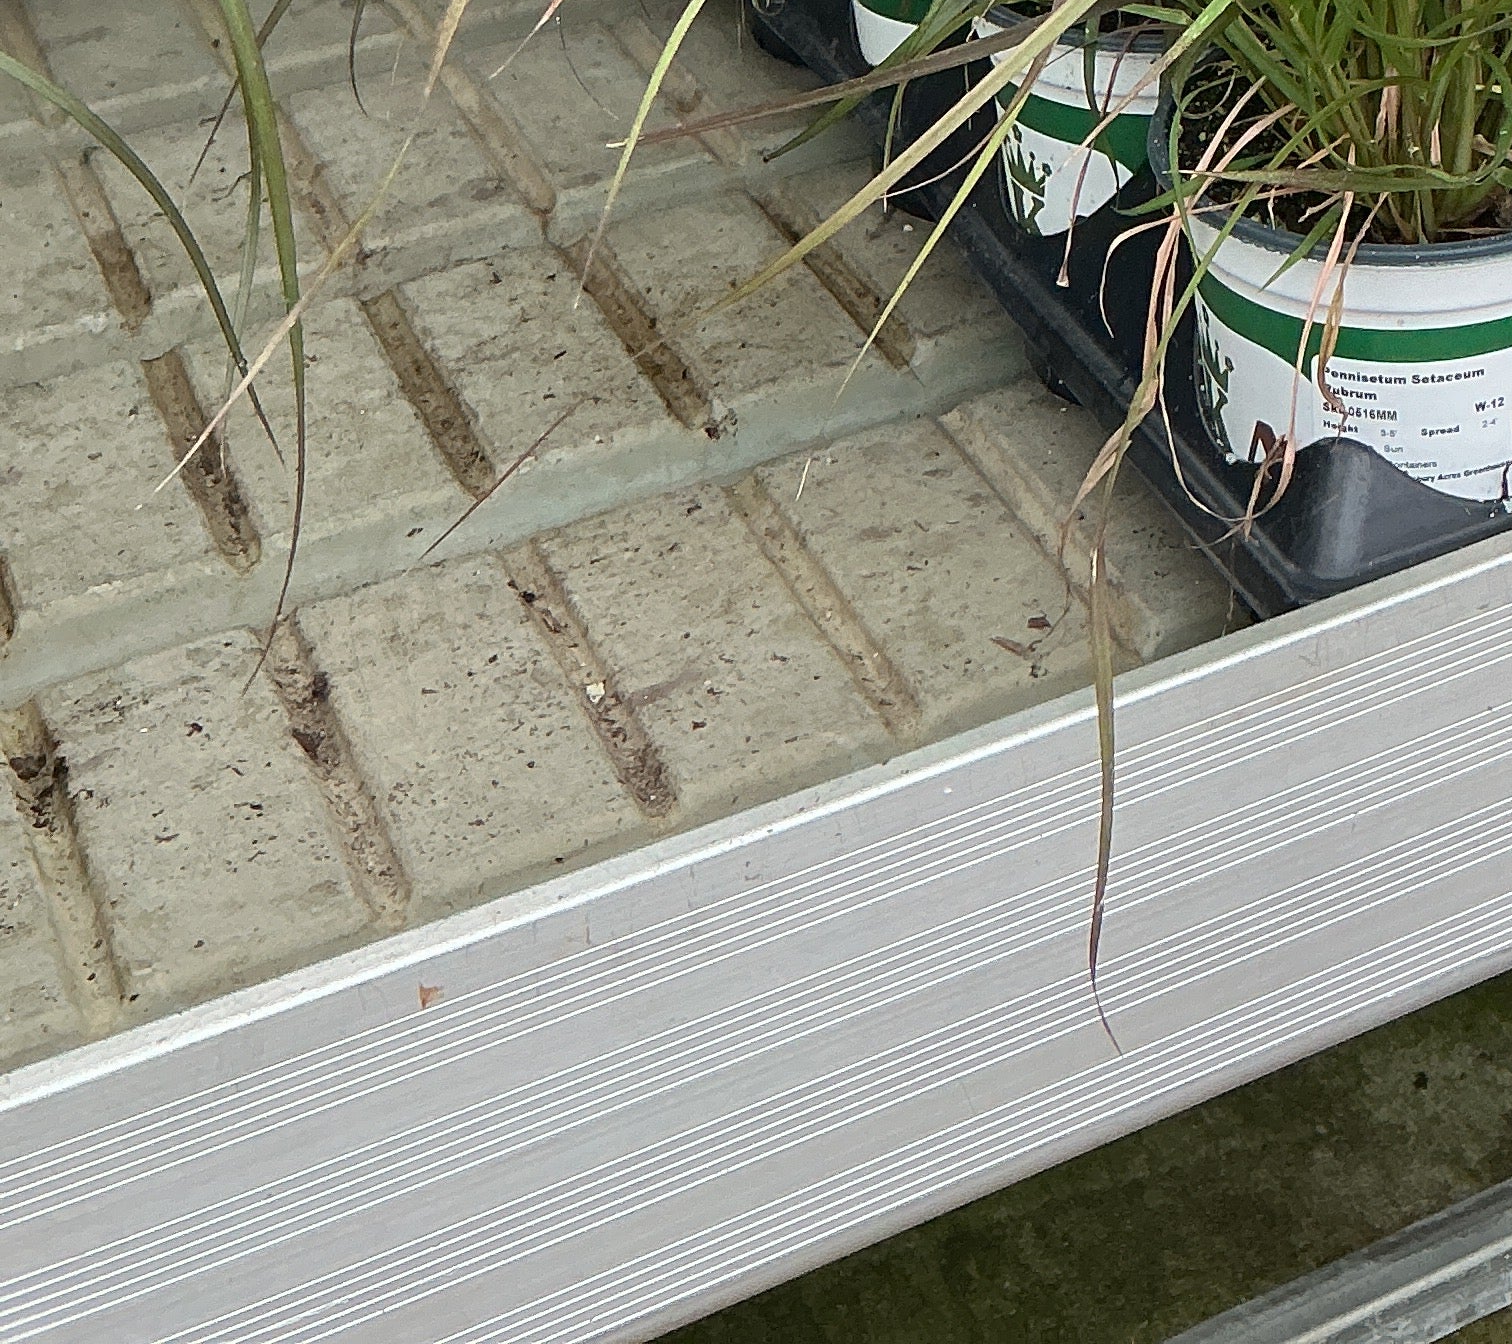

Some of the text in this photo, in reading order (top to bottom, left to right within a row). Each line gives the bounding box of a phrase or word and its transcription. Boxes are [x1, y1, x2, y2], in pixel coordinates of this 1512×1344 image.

[1411, 367, 1485, 385] Setaceum
[1474, 396, 1505, 413] W-12
[1420, 424, 1461, 438] Spread
[1392, 461, 1438, 470] ontainers
